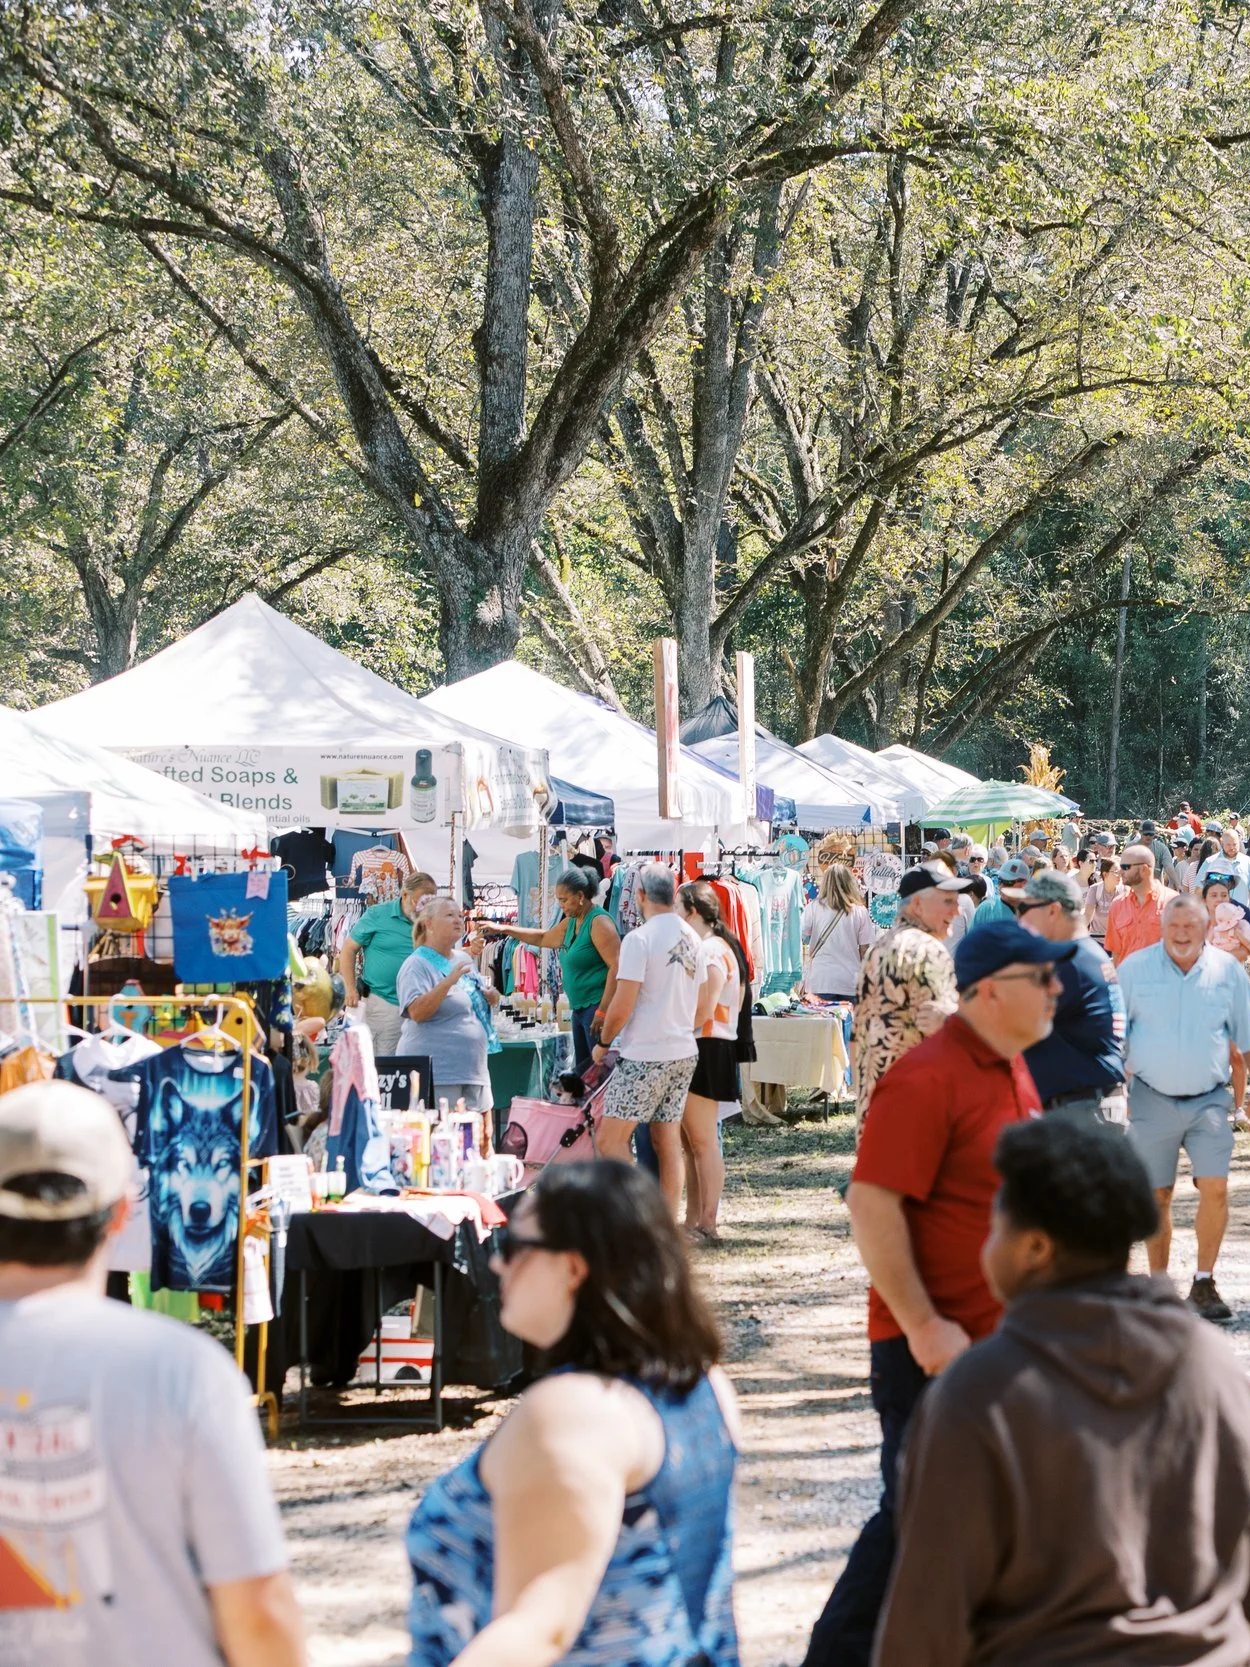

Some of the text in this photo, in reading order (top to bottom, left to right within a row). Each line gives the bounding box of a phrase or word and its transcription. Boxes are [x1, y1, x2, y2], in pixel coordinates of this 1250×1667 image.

[320, 752, 404, 761] www.naturesnuance.com
[211, 767, 276, 787] Soaps
[283, 767, 299, 785] &
[220, 792, 293, 811] Blends
[293, 814, 311, 824] oils
